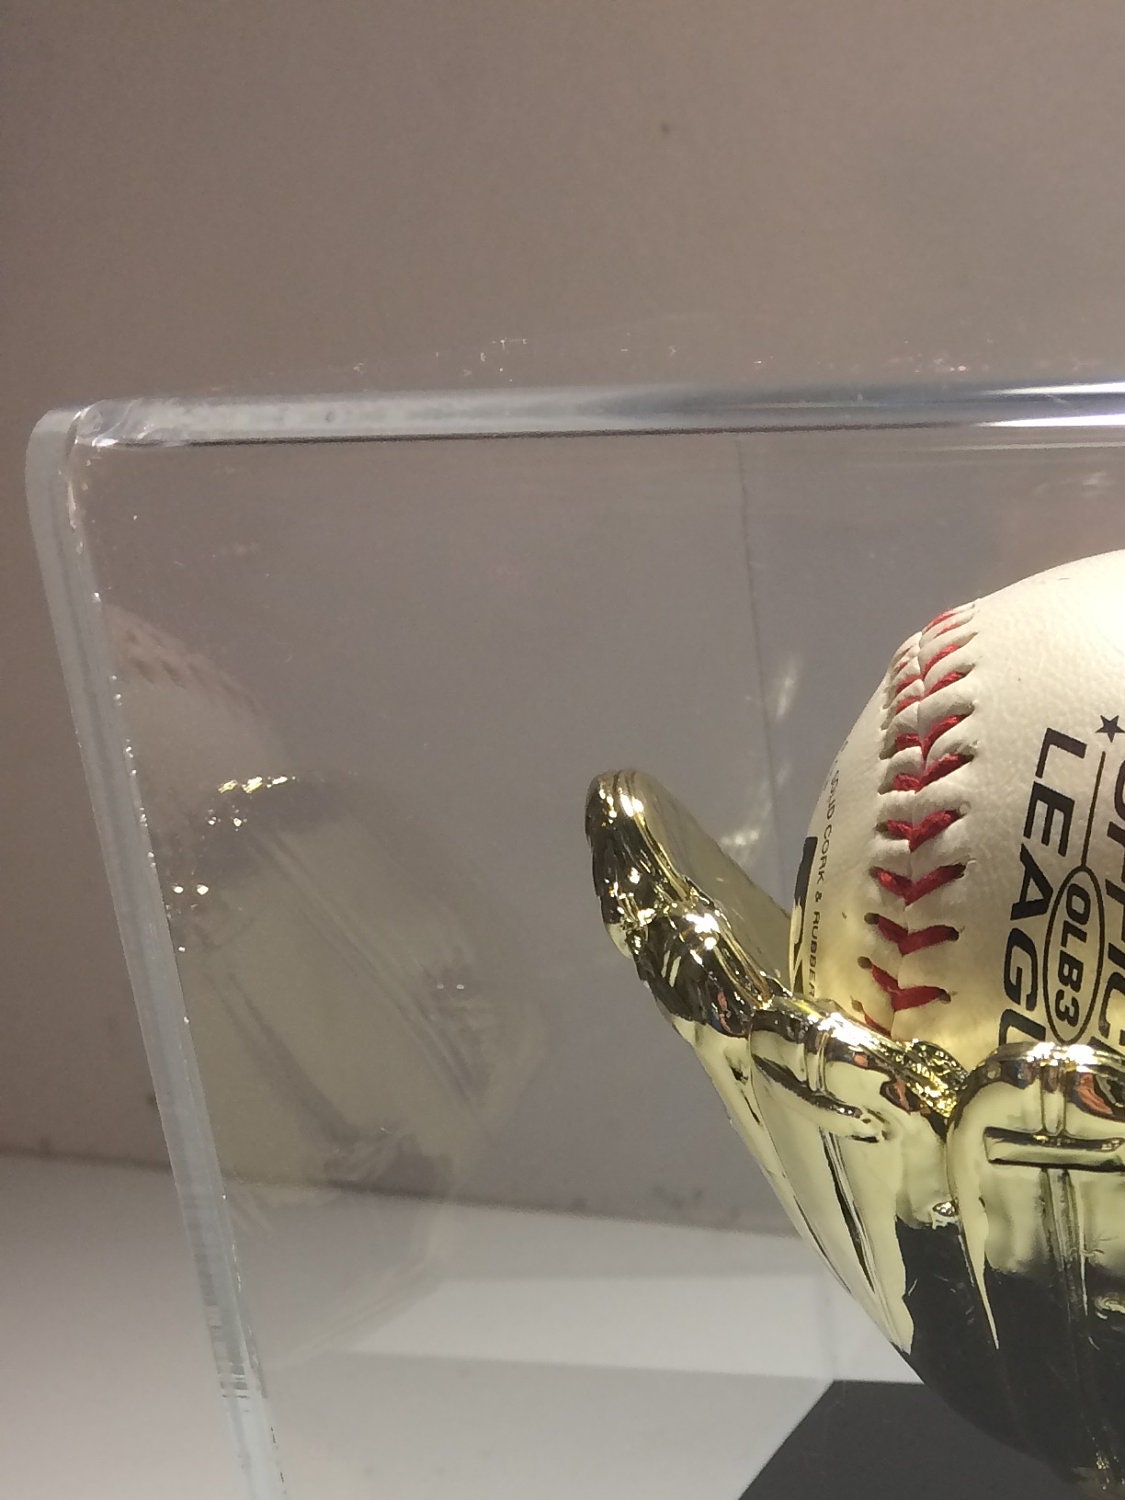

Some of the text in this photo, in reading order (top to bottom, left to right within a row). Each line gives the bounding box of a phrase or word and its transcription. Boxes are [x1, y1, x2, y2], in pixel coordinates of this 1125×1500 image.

[817, 824, 832, 884] CORK
[814, 890, 823, 903] &
[1055, 882, 1091, 1027] OLB3
